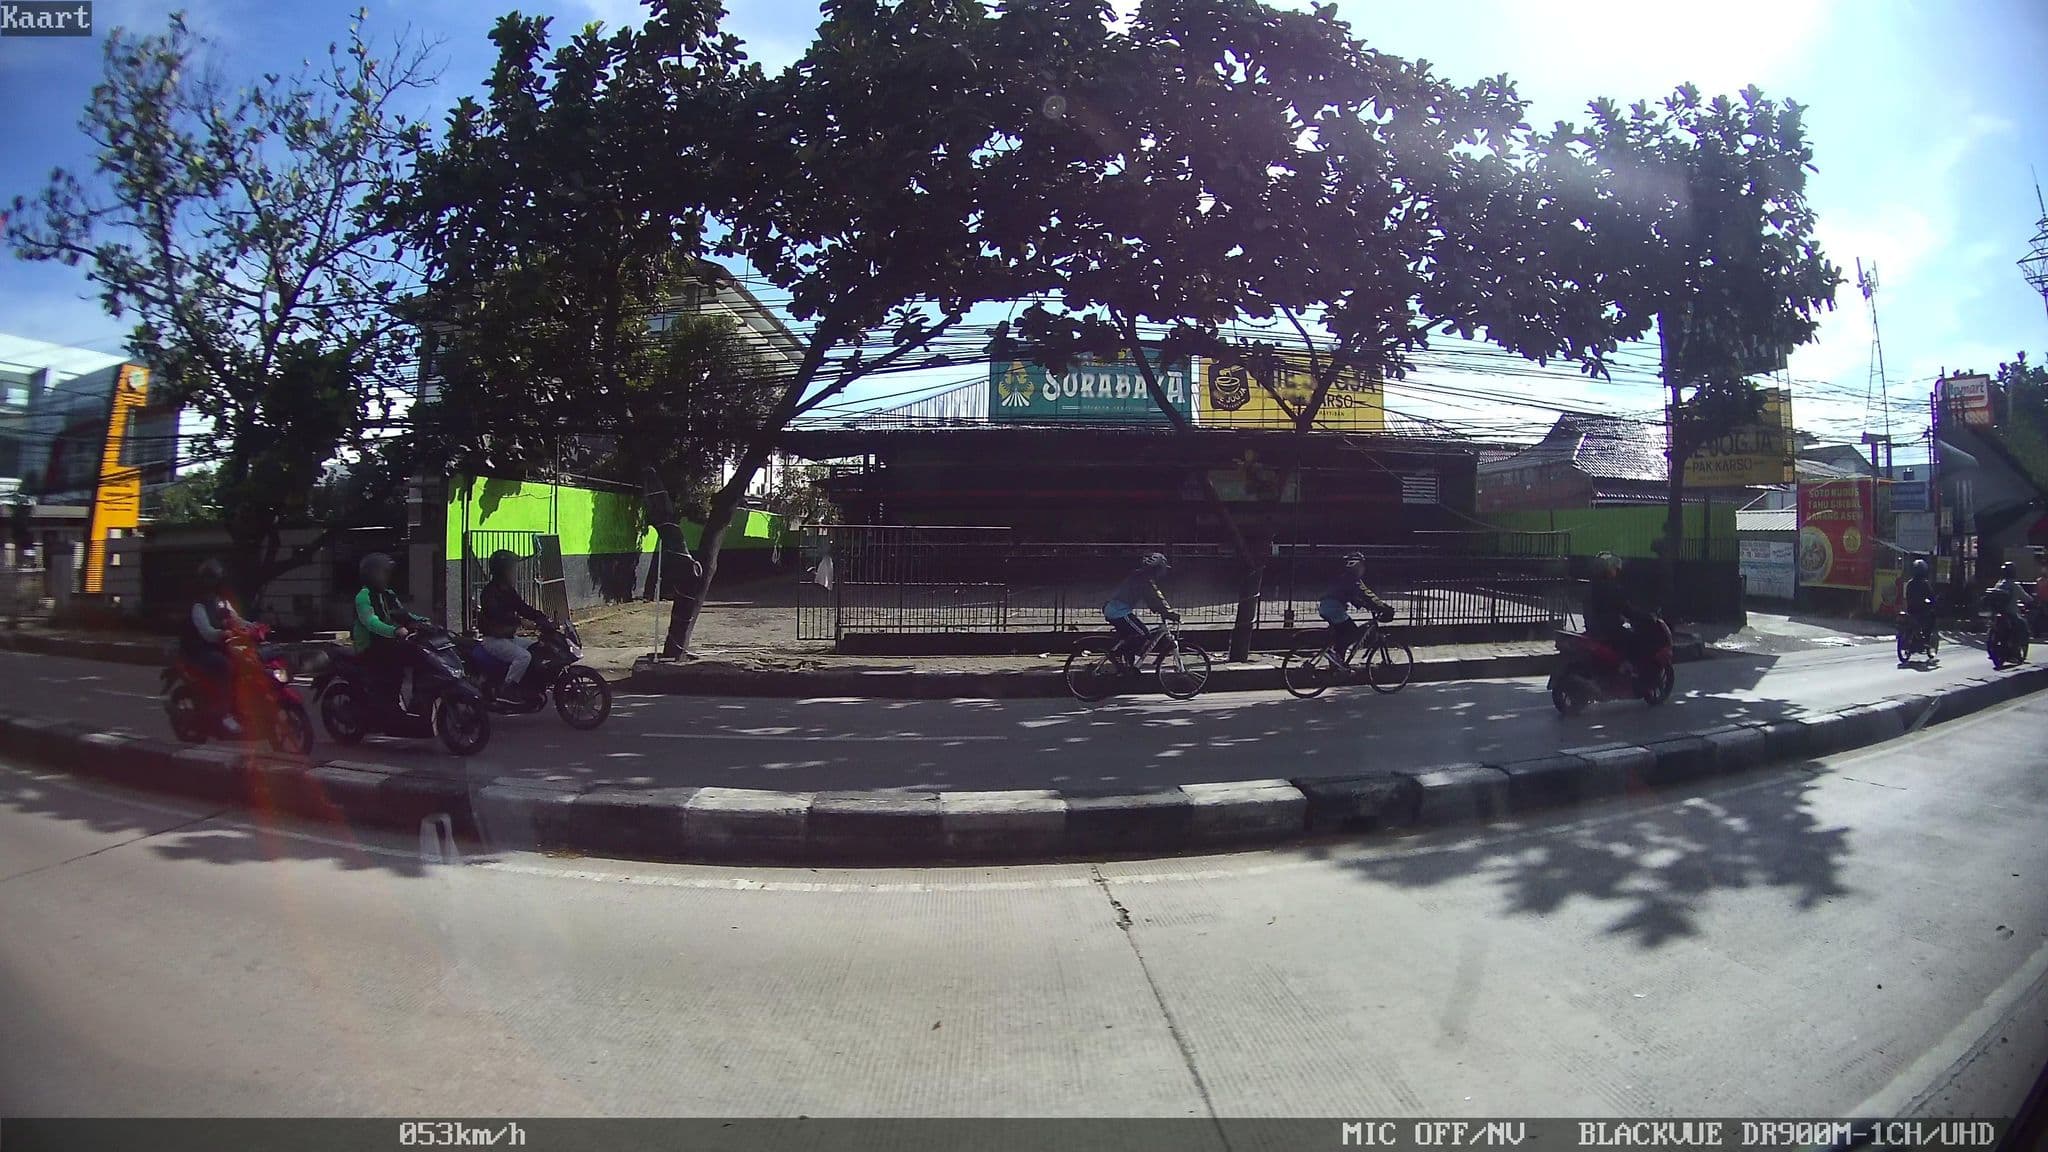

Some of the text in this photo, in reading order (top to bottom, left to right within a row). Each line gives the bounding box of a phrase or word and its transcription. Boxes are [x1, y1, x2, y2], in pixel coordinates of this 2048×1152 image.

[1692, 457, 1753, 474] PAK KARSO
[1808, 487, 1860, 498] SOTO KUDUS
[1808, 500, 1829, 509] TAHU
[1841, 510, 1864, 521] ASEM
